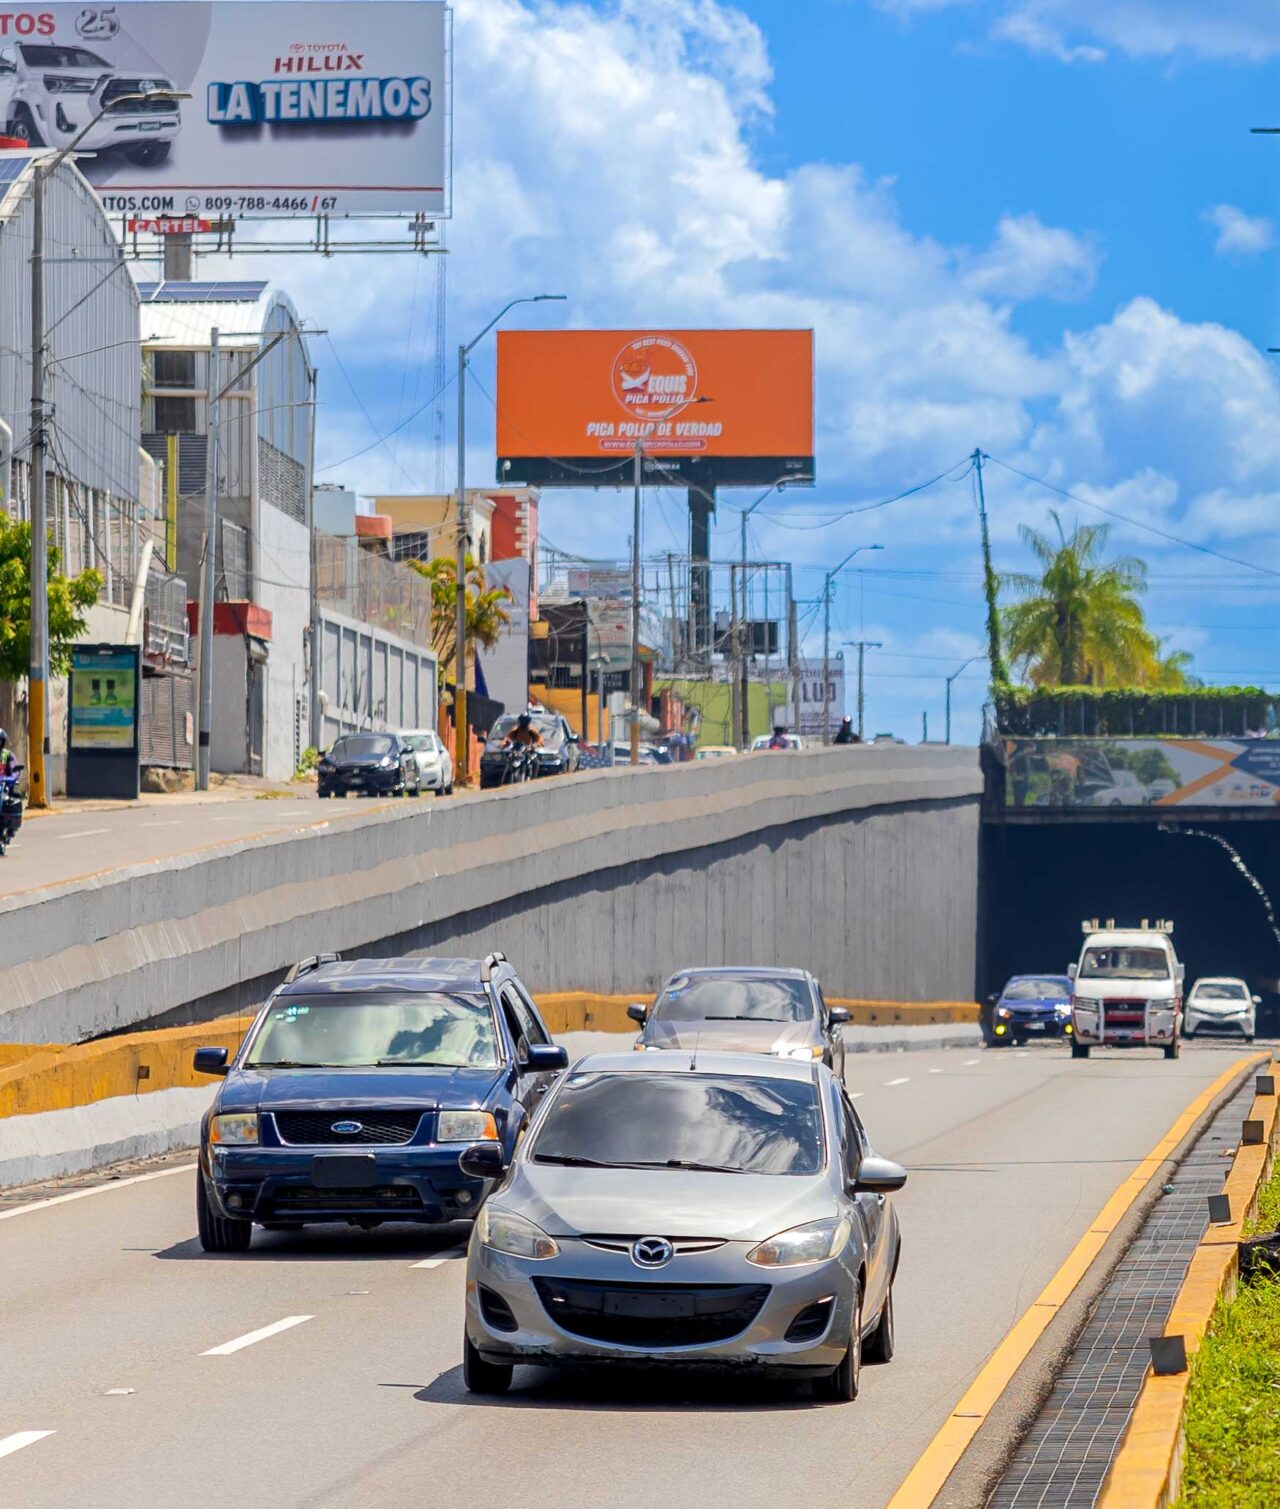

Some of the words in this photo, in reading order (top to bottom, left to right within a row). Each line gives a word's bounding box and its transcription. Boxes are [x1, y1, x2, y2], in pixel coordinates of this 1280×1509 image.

[0, 13, 56, 36] TOS
[81, 7, 118, 33] 25
[307, 43, 348, 52] TOYOTA
[273, 54, 365, 73] HILUX
[207, 82, 254, 121] LA
[260, 77, 432, 120] TENEMOS
[205, 196, 308, 211] 809-788-4466
[321, 197, 337, 210] 67
[134, 220, 204, 233] CARTEL
[648, 375, 687, 394] EQUIS
[626, 394, 649, 404] PICA
[652, 394, 685, 404] POLLO
[586, 421, 615, 436] PICA
[618, 421, 655, 436] POLLO
[657, 422, 673, 436] DE
[676, 422, 722, 436] VERDAD
